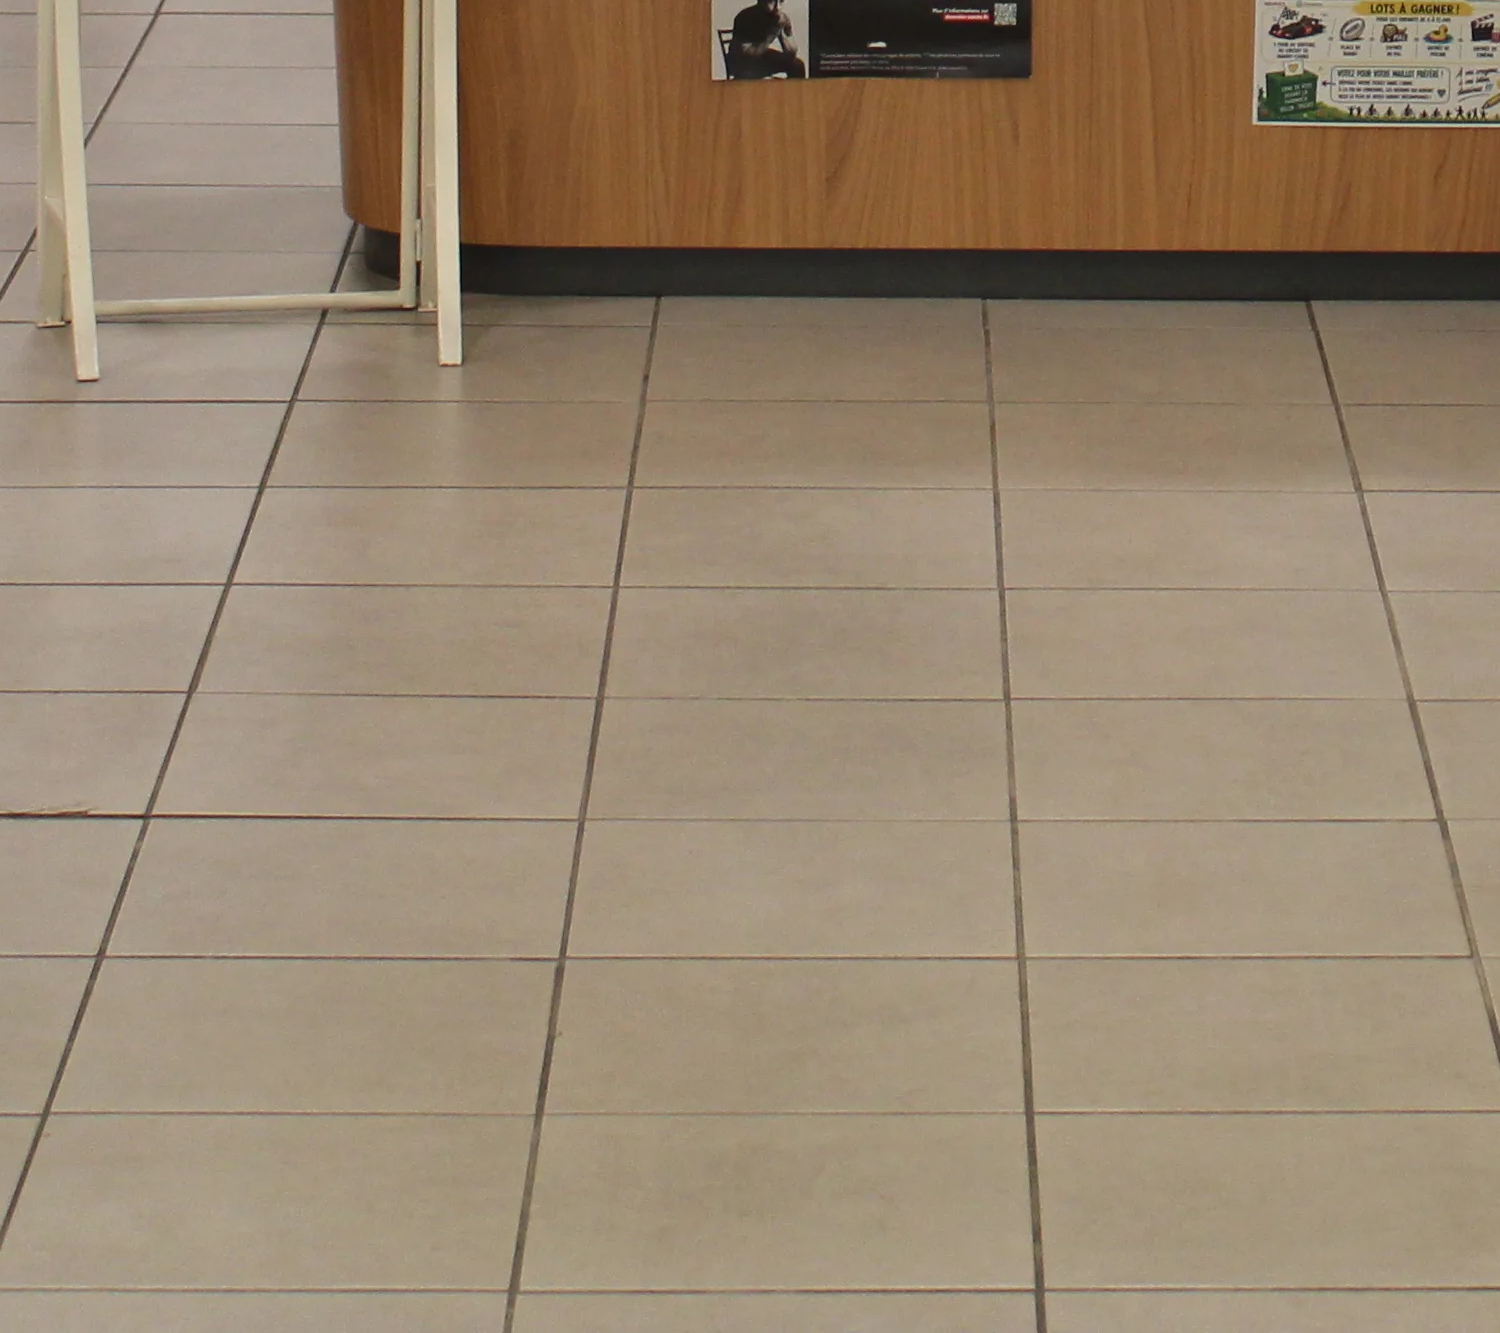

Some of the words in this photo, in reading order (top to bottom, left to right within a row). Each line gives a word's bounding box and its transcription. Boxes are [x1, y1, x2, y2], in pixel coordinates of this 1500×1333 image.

[1370, 3, 1396, 15] LOTS
[1399, 1, 1408, 15] À
[1410, 3, 1454, 15] GAGNER
